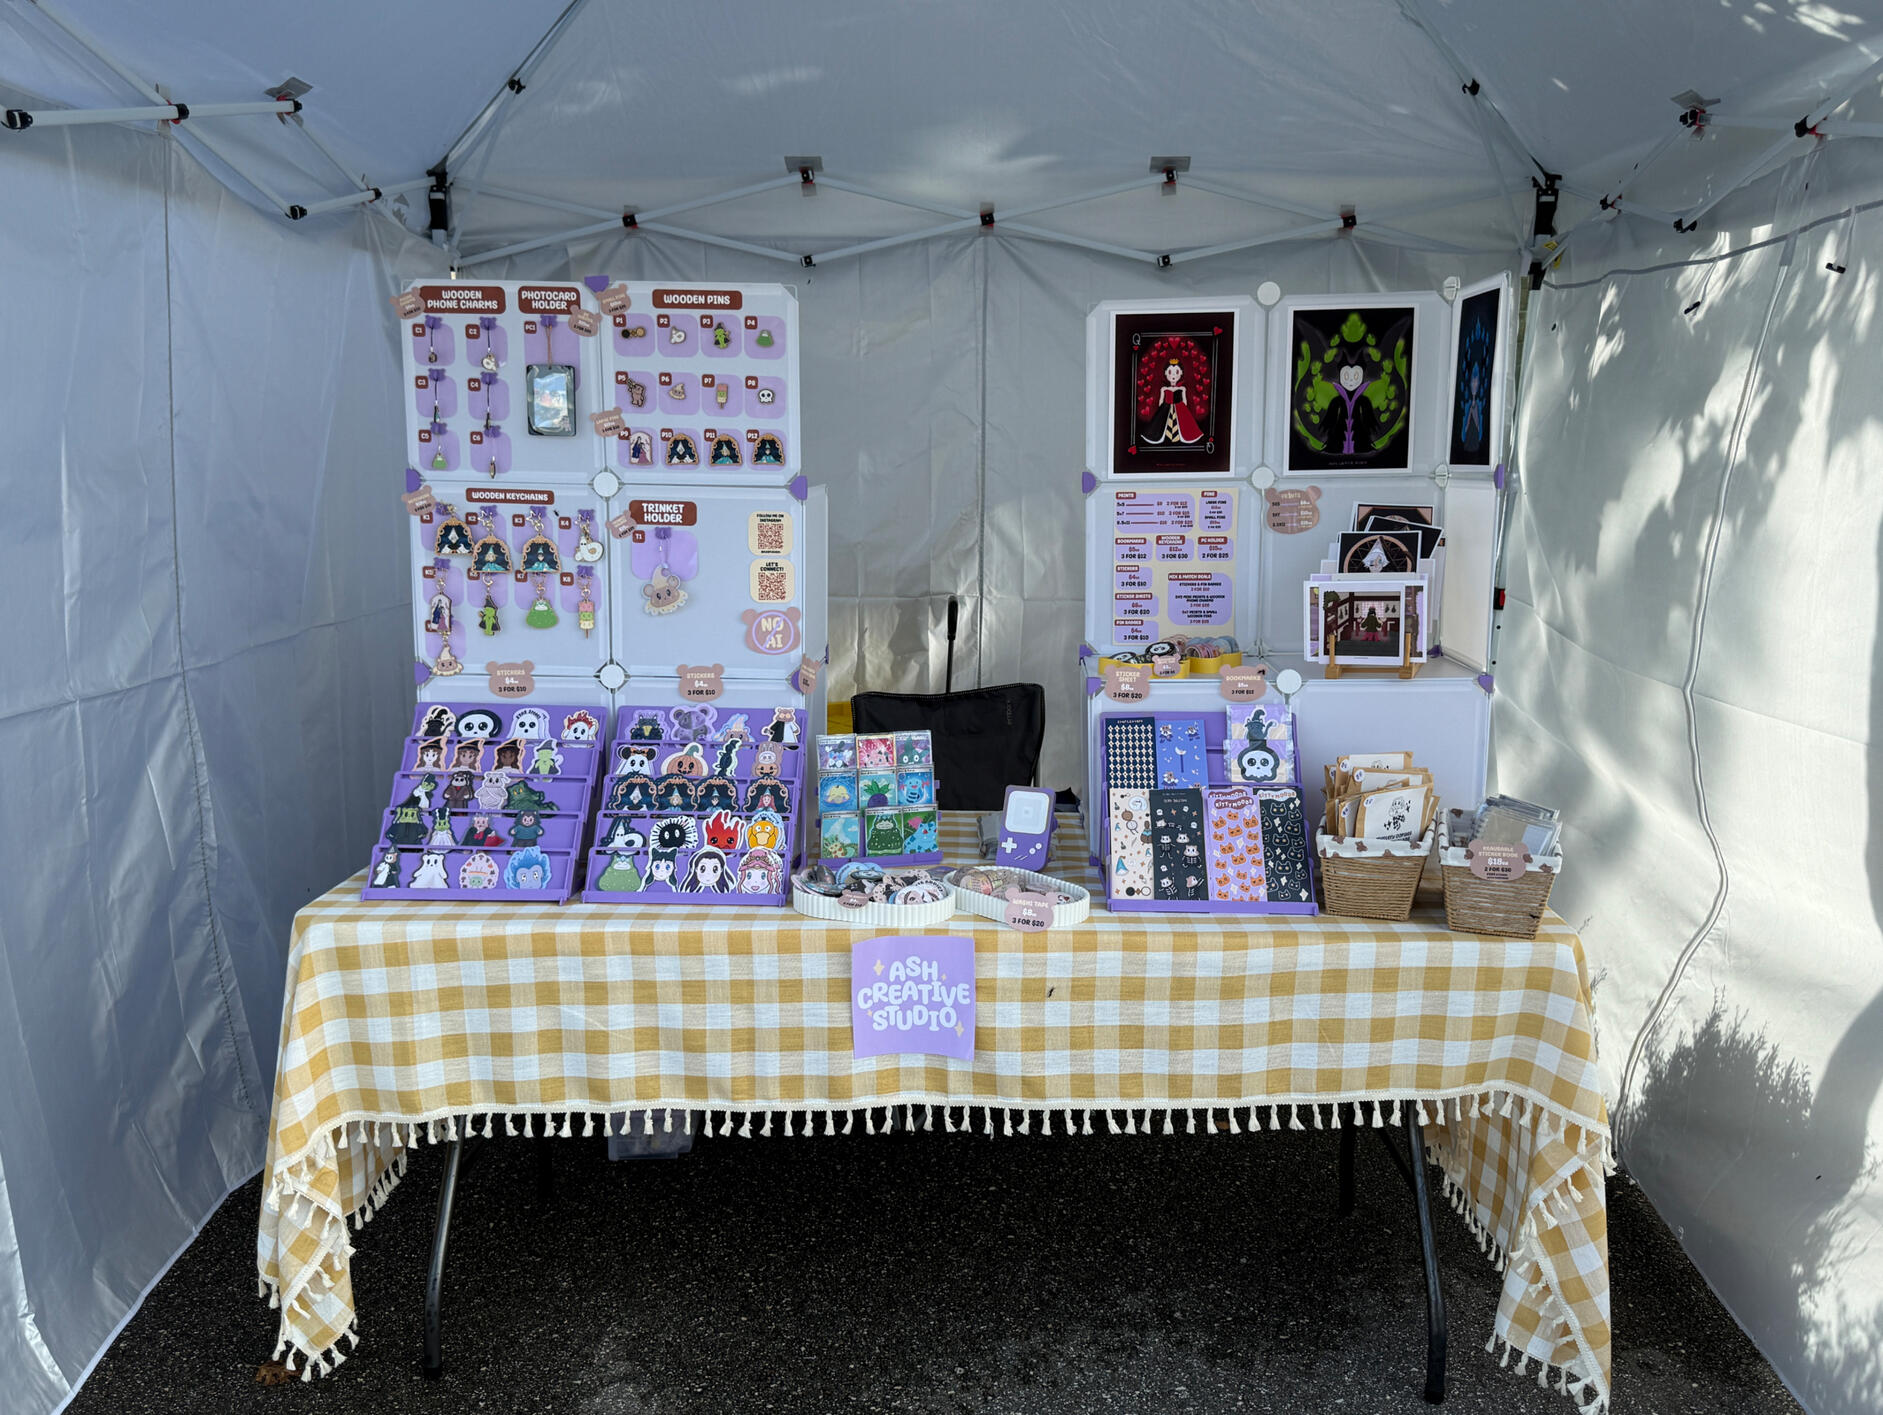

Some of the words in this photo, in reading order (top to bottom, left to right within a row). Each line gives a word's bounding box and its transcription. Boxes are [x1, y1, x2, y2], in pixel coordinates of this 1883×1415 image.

[442, 290, 482, 299] WOODEN
[522, 291, 577, 300] PHOTOCARD
[664, 294, 706, 304] WOODEN
[707, 295, 730, 305] PINS
[428, 300, 458, 308] PHONE
[460, 300, 498, 309] CHARMS
[532, 300, 568, 310] HOLDER
[1132, 333, 1140, 346] Q
[472, 492, 504, 500] WOODEN
[506, 492, 548, 501] KEYCHAINS
[642, 504, 684, 513] TRINKET
[644, 513, 683, 523] HOLDER
[761, 617, 784, 632] NO
[766, 634, 782, 648] AI
[1232, 799, 1252, 807] MOODS
[889, 956, 938, 982] ASH
[858, 981, 970, 1010] CREATIVE
[872, 1005, 957, 1032] STUDIO
